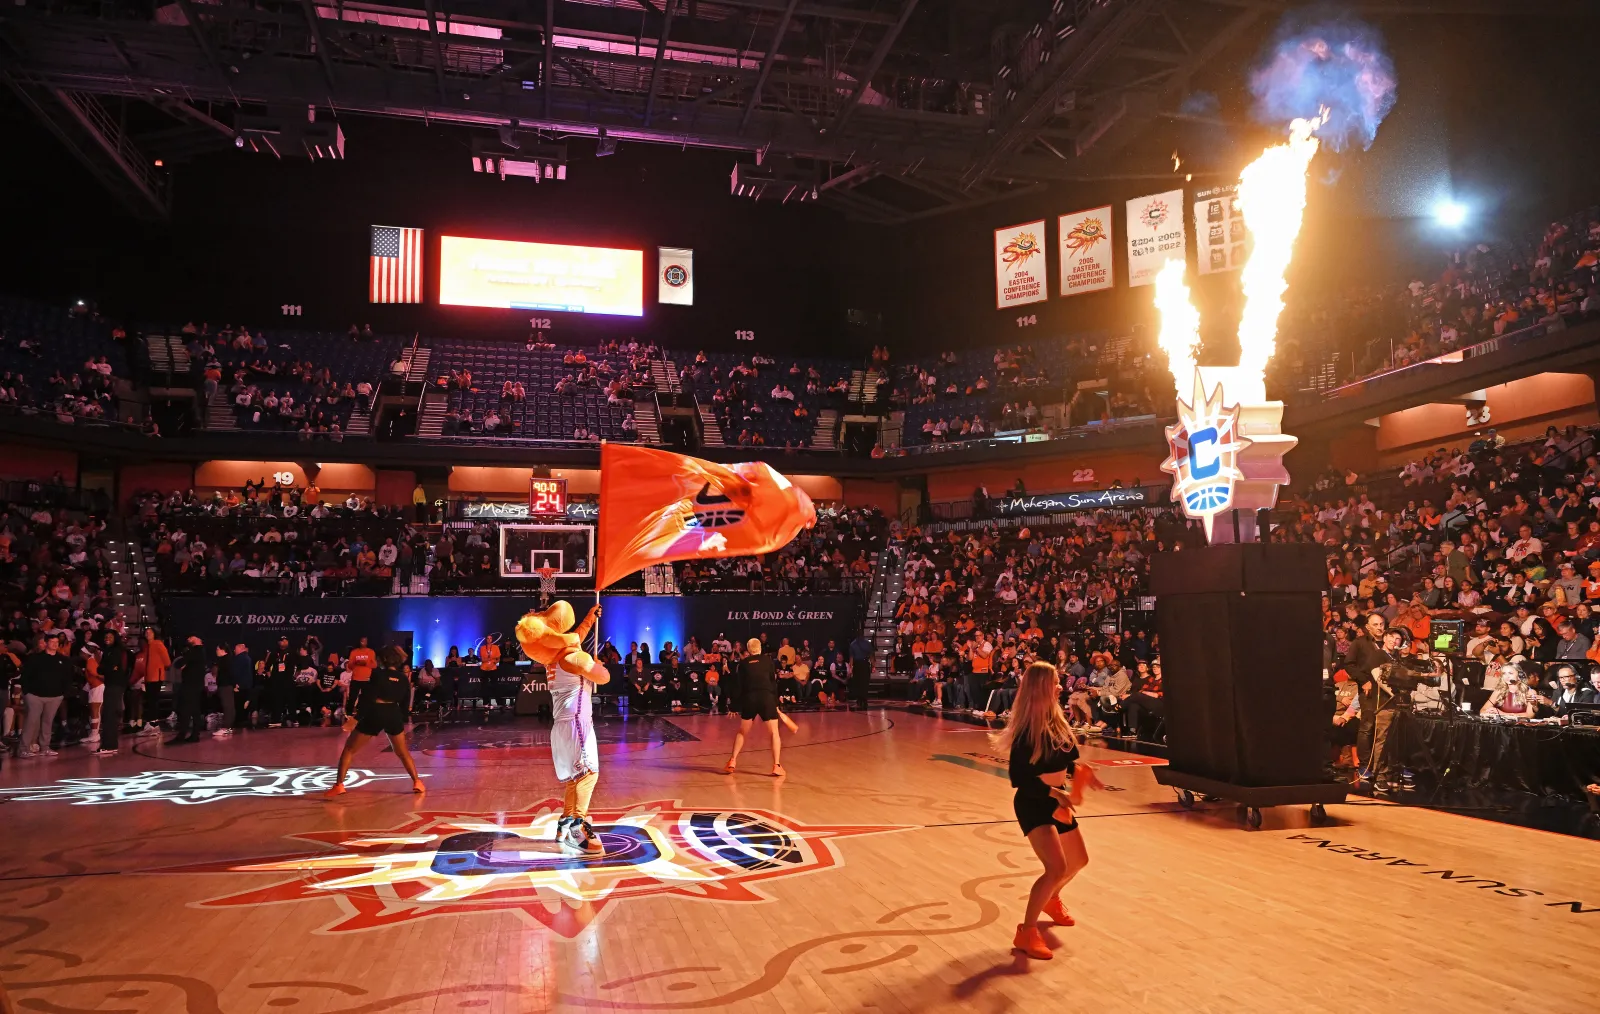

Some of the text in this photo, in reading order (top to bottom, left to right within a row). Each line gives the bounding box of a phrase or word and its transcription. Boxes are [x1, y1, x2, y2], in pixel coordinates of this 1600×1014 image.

[1158, 231, 1181, 242] 2005
[1158, 241, 1181, 252] 2022
[1078, 257, 1094, 265] 2005
[1073, 263, 1100, 273] EASTERN
[1008, 275, 1035, 286] EASTERN
[1067, 269, 1107, 281] CONFERENCE
[1003, 281, 1041, 294] CONFERENCE
[1068, 277, 1105, 288] CHAMPIONS
[1005, 289, 1040, 301] CHAMPIONS
[281, 304, 302, 316] 111
[530, 318, 551, 329] 112
[1016, 314, 1037, 328] 114
[735, 330, 755, 341] 113
[1466, 405, 1491, 426] 23
[1188, 427, 1221, 480] C
[273, 471, 294, 486] 19
[1072, 468, 1094, 483] 22
[536, 493, 560, 511] 24
[1010, 491, 1145, 511] Mohegan Sun Arena
[479, 502, 599, 518] Mohega Are
[215, 613, 348, 624] LUX BOND & GREEN
[727, 610, 834, 620] LUX BOND & GREEN
[1286, 833, 1428, 867] ARENA
[1420, 869, 1545, 898] SUN
